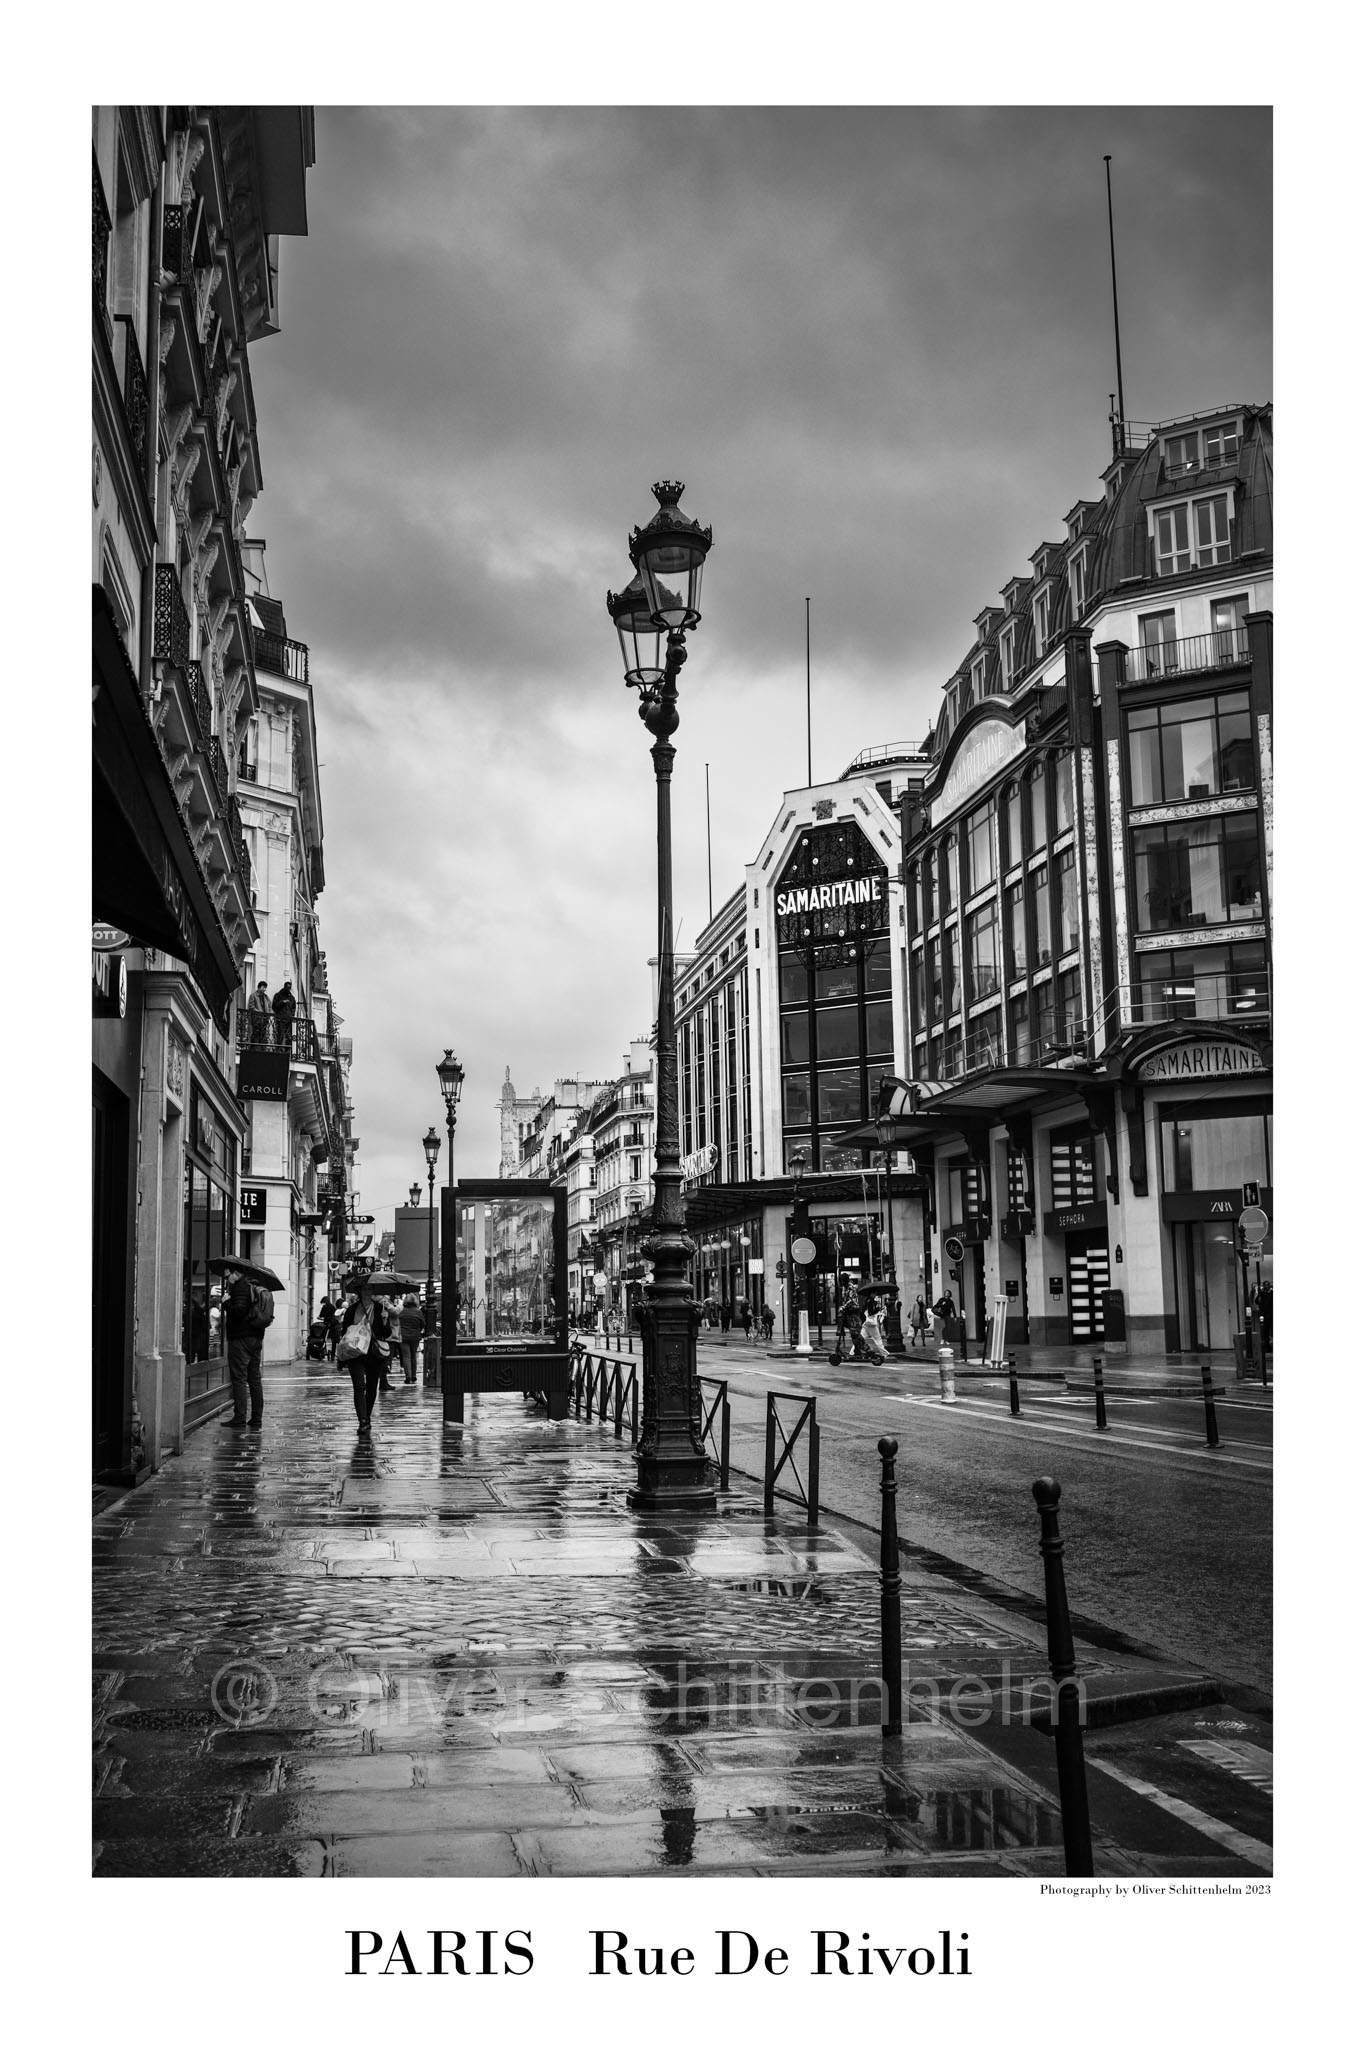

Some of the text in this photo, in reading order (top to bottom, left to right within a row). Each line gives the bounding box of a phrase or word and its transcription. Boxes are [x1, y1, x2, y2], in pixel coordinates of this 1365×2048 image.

[946, 730, 1004, 802] SAMARITAINE
[777, 877, 882, 916] SAMARITAINE
[1145, 1045, 1261, 1077] SAMARITAINE
[242, 1085, 283, 1095] CAROLL
[240, 1192, 258, 1206] IE
[1210, 1201, 1233, 1213] ZARA
[1059, 1213, 1085, 1227] SEPHORA
